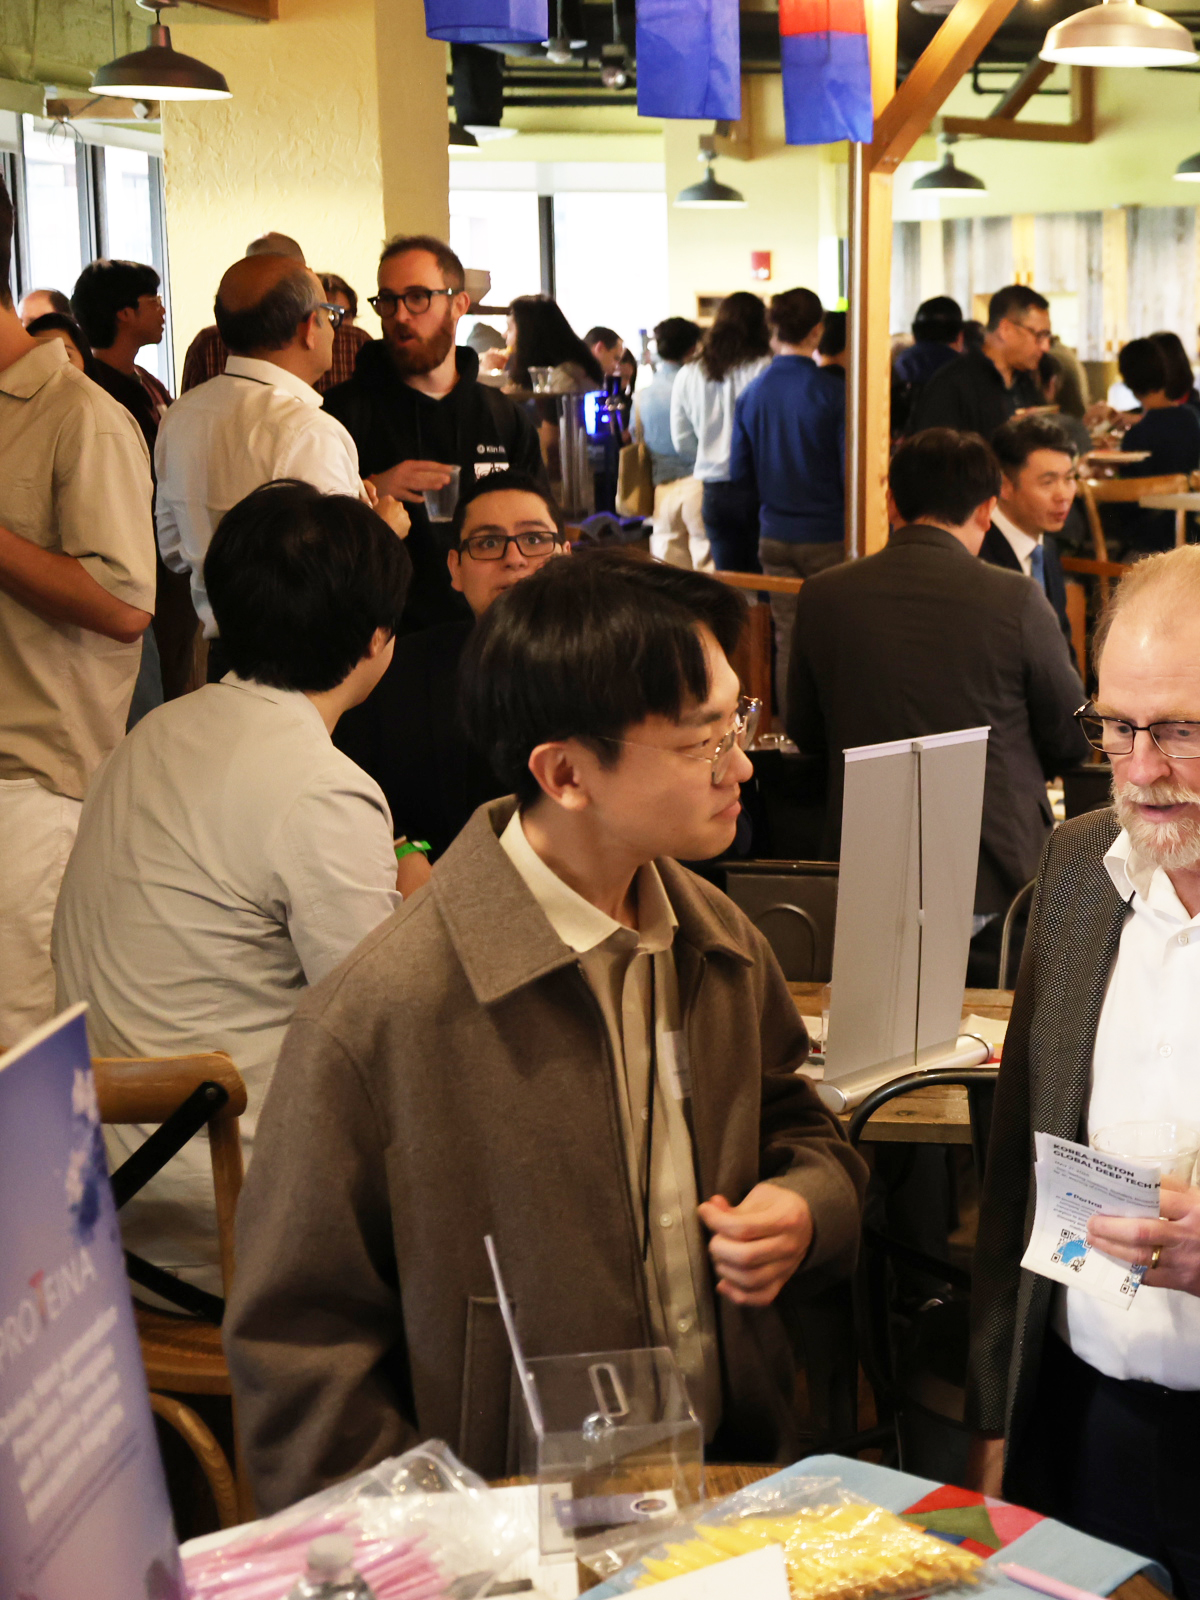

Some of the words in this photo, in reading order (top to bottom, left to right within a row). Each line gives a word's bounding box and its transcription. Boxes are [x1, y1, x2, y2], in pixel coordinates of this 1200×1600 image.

[1053, 1150, 1093, 1169] GLOBAL
[1095, 1166, 1122, 1180] DEEP
[1124, 1177, 1152, 1189] TECH
